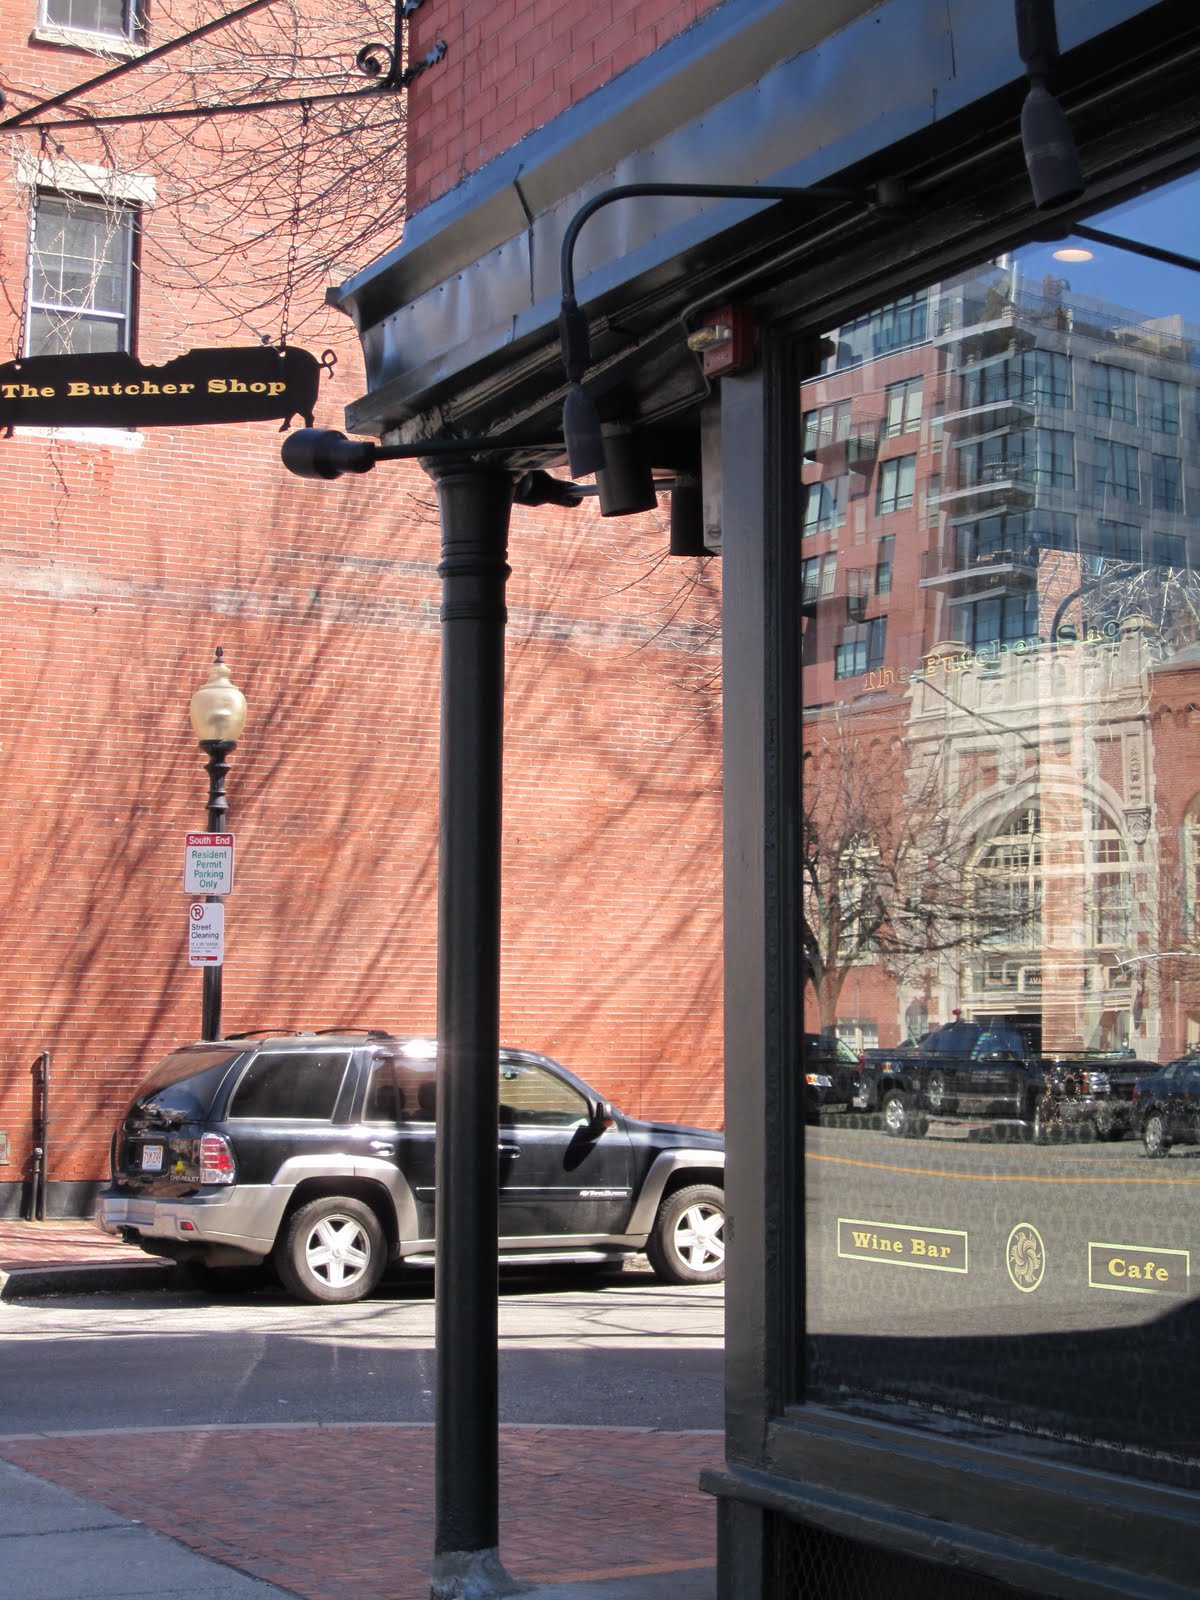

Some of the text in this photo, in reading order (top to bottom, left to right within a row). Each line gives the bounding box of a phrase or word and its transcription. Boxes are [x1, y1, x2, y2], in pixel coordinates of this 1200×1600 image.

[1, 379, 287, 398] The Butcher Shop
[863, 666, 911, 691] The
[922, 634, 1044, 676] Butcher
[189, 836, 230, 845] South End
[191, 850, 227, 859] Resident
[196, 860, 222, 869] Permit
[194, 870, 224, 880] Parking
[199, 880, 218, 889] Only
[191, 923, 211, 931] Street
[191, 932, 219, 940] Cleaning
[851, 1231, 952, 1259] Wine Bar
[1108, 1257, 1169, 1281] Cafe
